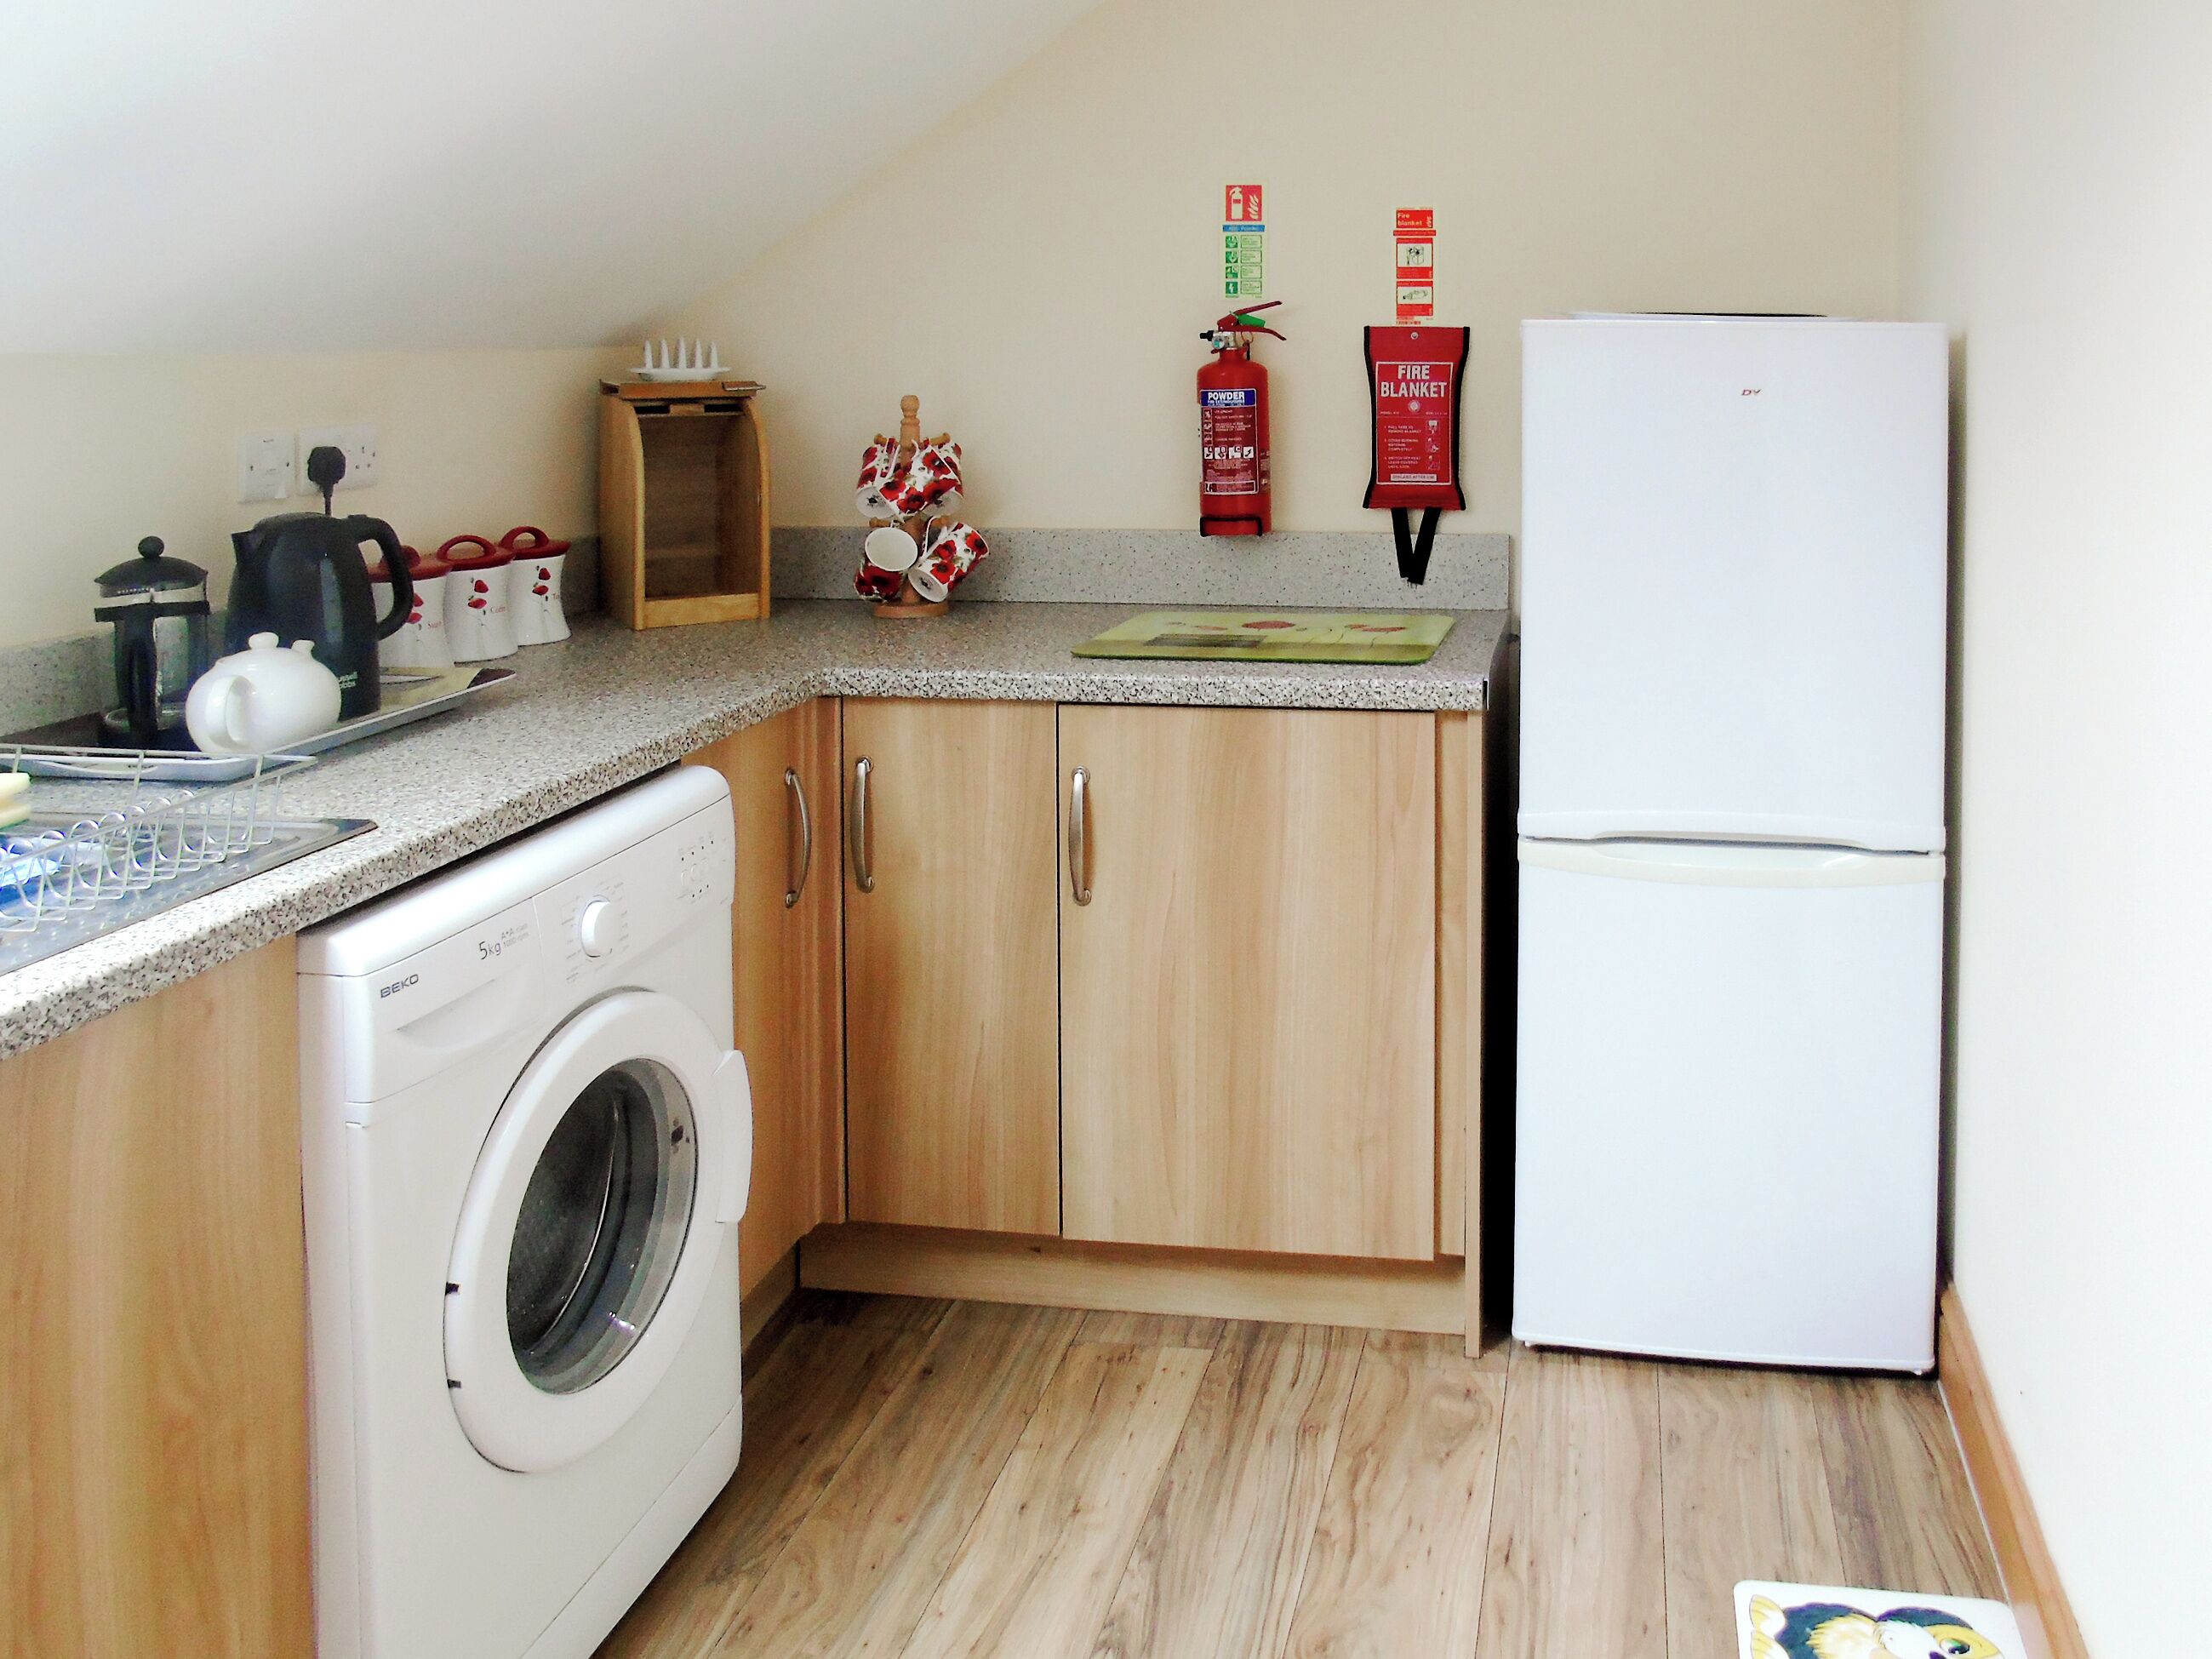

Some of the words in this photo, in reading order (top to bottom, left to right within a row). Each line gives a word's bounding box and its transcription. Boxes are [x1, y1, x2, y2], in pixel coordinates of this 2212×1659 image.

[1398, 365, 1430, 380] FIRE
[1208, 392, 1245, 400] POWDER
[1380, 381, 1447, 398] BLANKET
[478, 941, 501, 959] 5kg
[380, 974, 420, 998] BEKO
